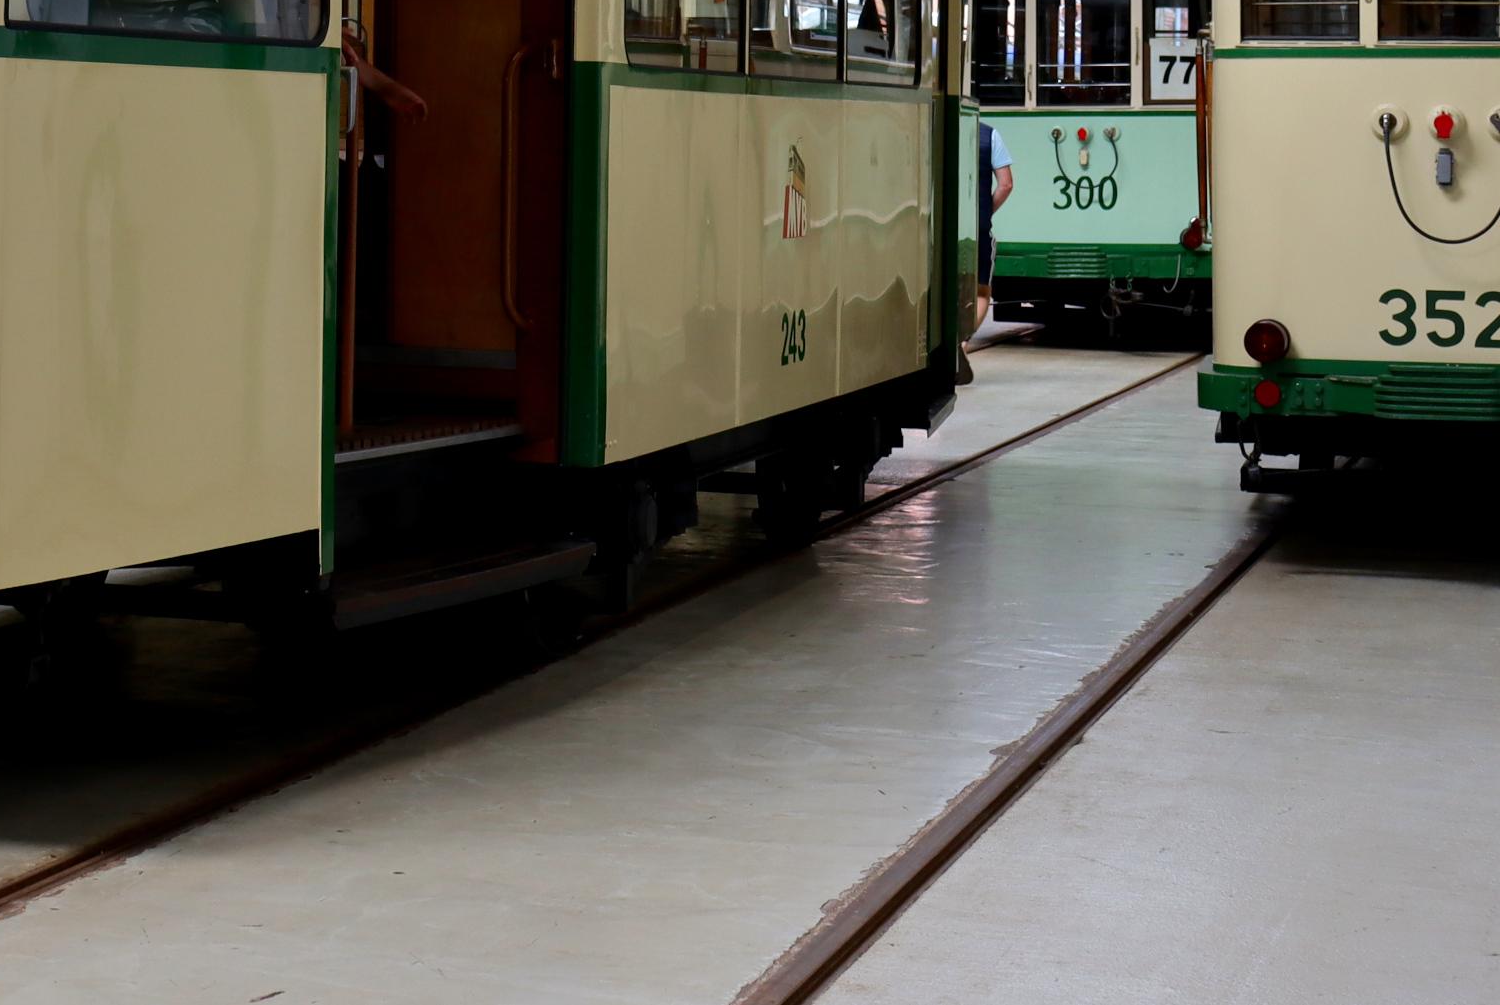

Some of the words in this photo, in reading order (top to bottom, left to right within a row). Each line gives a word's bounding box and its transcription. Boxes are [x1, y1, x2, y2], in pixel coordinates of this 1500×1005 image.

[1159, 55, 1196, 84] 77
[1053, 175, 1118, 210] 300
[781, 309, 806, 366] 243
[1379, 289, 1500, 348] 352
